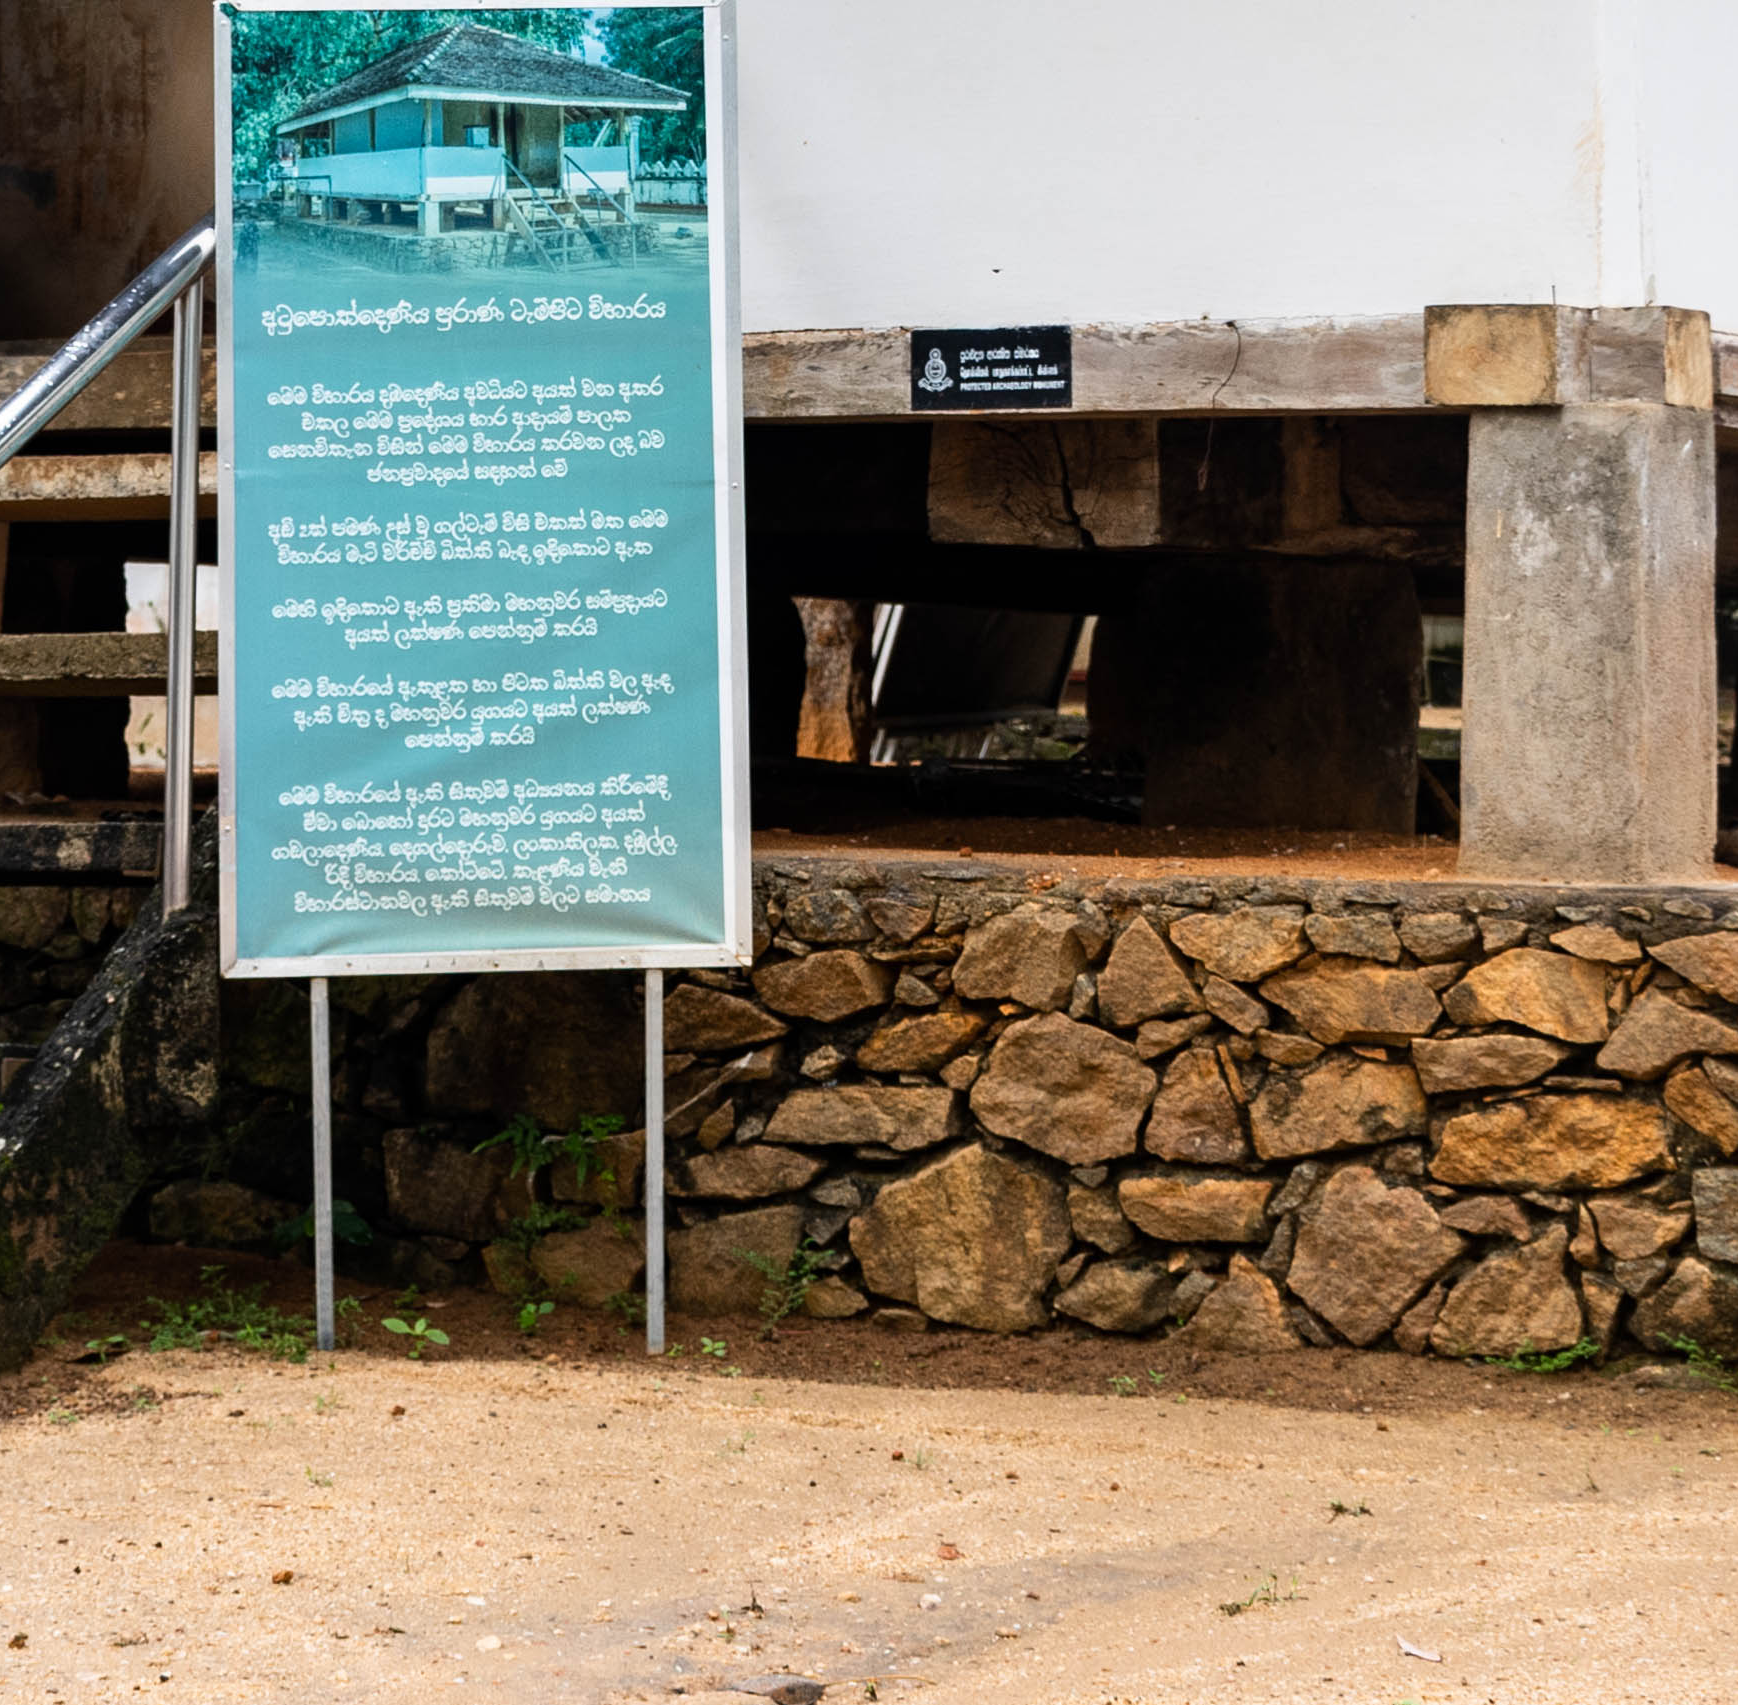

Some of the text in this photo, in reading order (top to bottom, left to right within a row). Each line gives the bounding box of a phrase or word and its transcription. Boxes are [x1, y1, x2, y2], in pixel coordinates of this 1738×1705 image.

[435, 297, 505, 331] පුරාණ
[510, 297, 583, 324] ටැම්පිට
[588, 293, 666, 320] විහාරය
[267, 385, 308, 405] මෙම
[312, 383, 375, 404] විහාරය
[532, 376, 577, 405] අයත්
[581, 378, 615, 398] වන
[619, 374, 665, 403] අතර
[959, 382, 992, 392] PROTECTED
[1033, 380, 1065, 390] MONUMENT
[353, 410, 393, 430] මෙම
[377, 433, 424, 457] විසින්
[428, 435, 469, 455] මෙම
[472, 427, 536, 453] විහාරය
[637, 429, 666, 450] බව
[540, 457, 569, 479] වේ
[331, 514, 382, 537] පමණ
[590, 510, 625, 531] මත
[628, 509, 670, 528] මෙම
[277, 543, 342, 565] විහාරය
[614, 539, 654, 563] ඇත
[403, 595, 443, 622] ඇති
[505, 589, 581, 617] මහනුවර
[344, 620, 391, 650] අයත්
[271, 679, 313, 699] මෙම
[316, 673, 394, 697] විහාරයේ
[472, 677, 497, 694] හා
[609, 670, 638, 696] වල
[532, 694, 578, 725] අයත්
[278, 785, 320, 806] මෙම
[323, 780, 402, 805] විහාරයේ
[601, 800, 646, 829] අයත්
[539, 884, 580, 912] වලට
[584, 883, 652, 905] සමානය
